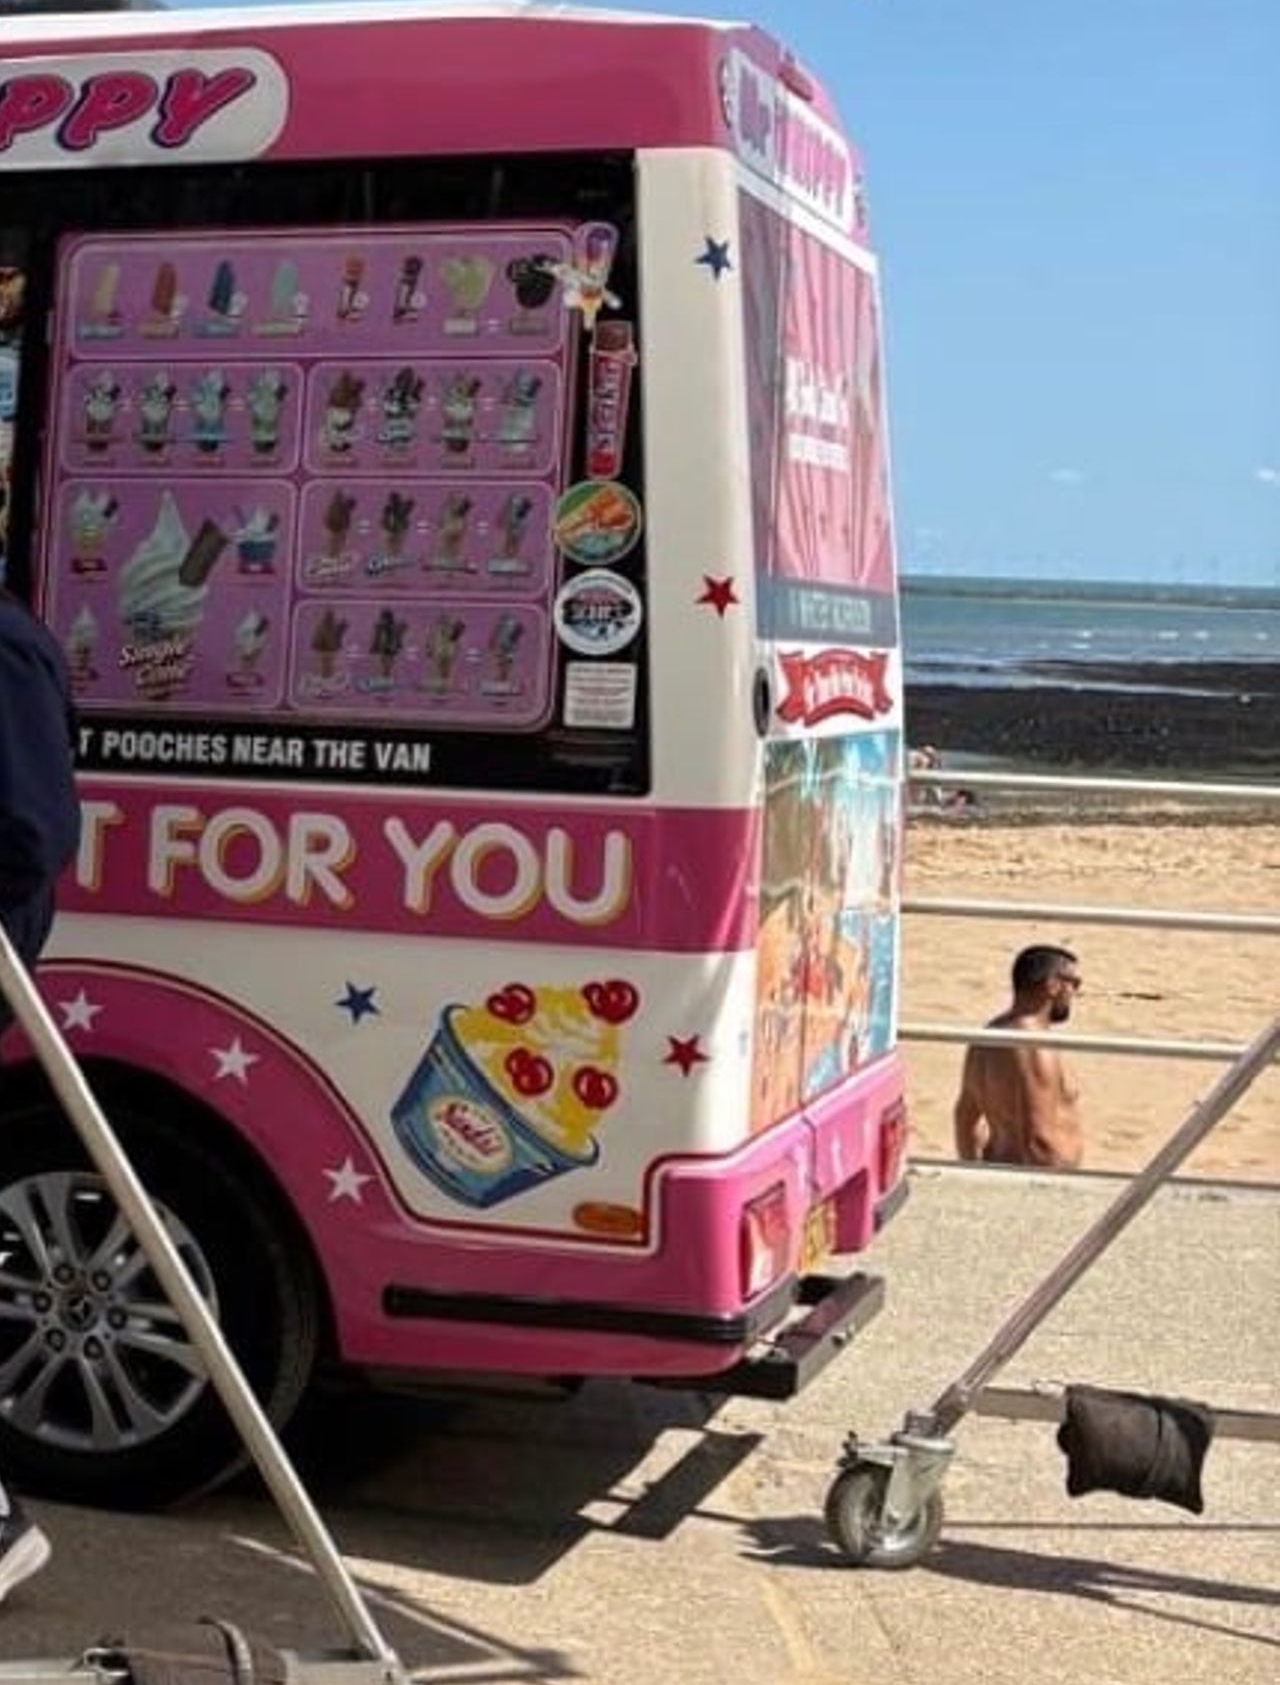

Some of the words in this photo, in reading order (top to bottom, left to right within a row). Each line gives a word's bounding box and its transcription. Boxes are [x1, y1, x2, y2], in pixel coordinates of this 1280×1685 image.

[102, 731, 226, 764] POOCHES
[233, 736, 304, 768] NEAR
[313, 739, 365, 770] THE
[375, 741, 431, 773] VAN
[148, 804, 355, 909] FOR
[383, 817, 632, 923] YOU
